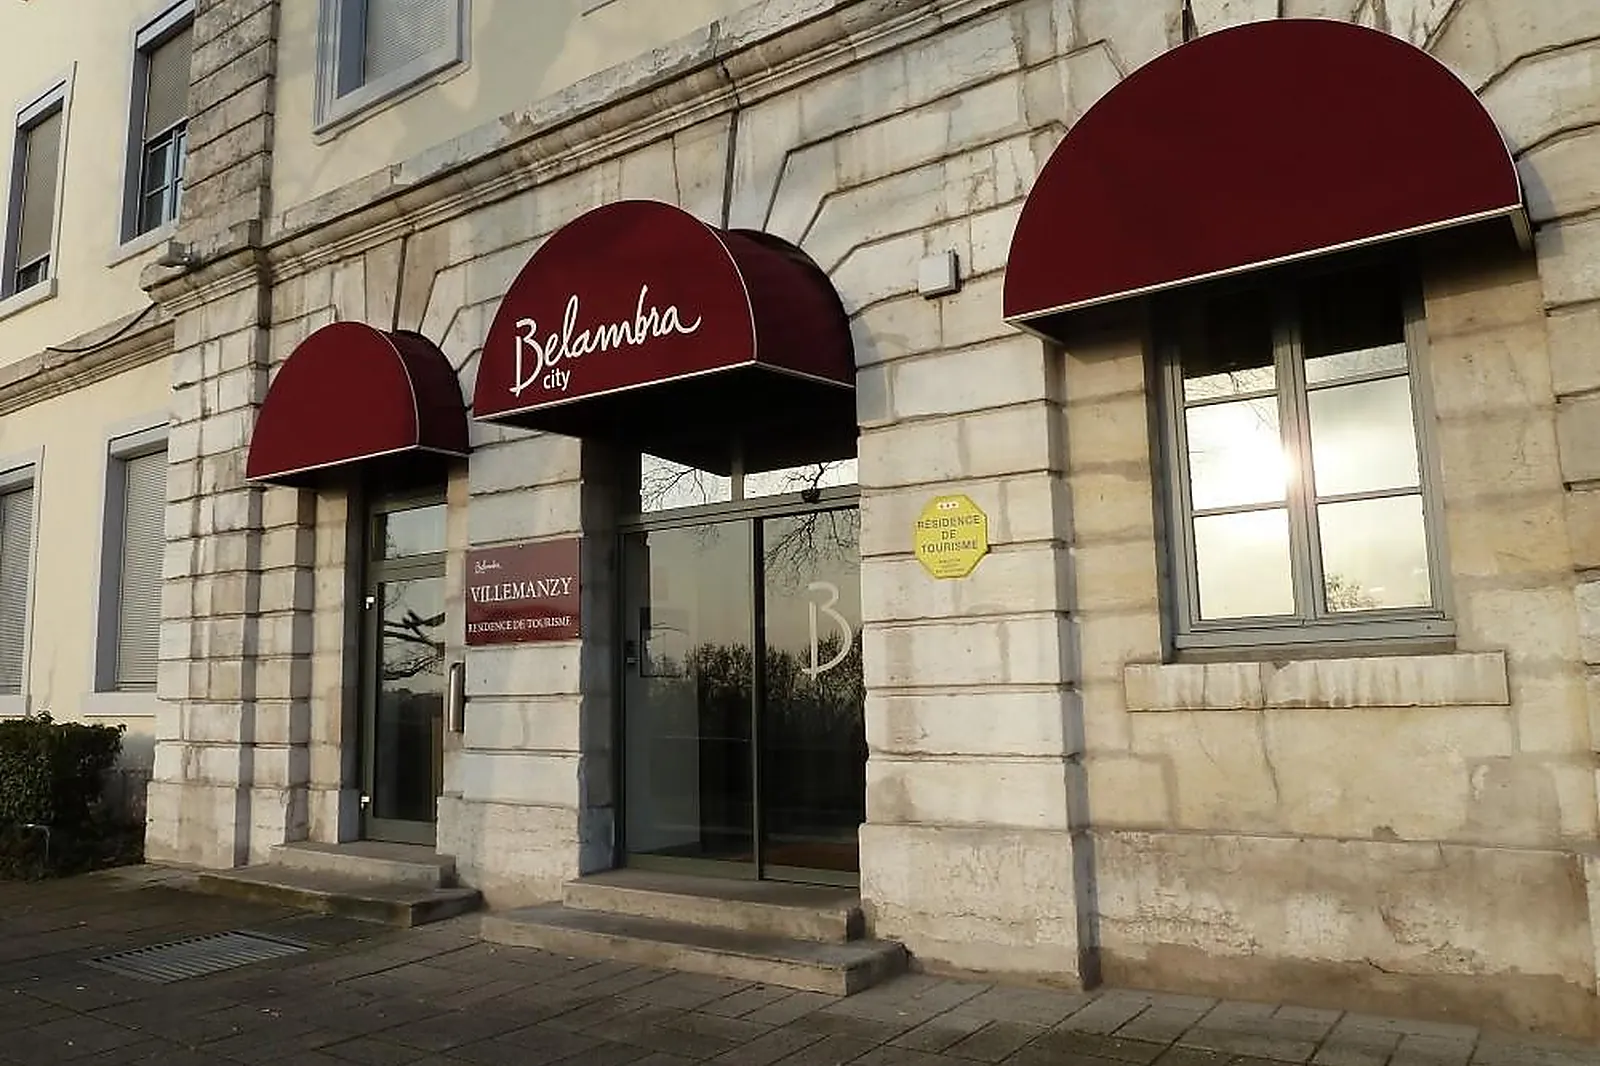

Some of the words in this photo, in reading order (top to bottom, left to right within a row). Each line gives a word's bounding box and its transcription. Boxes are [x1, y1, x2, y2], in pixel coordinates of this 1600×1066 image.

[509, 284, 702, 398] Belambra
[542, 368, 571, 391] city
[921, 539, 979, 553] TOURISME
[941, 529, 957, 540] DE
[470, 577, 573, 603] VILLEMANZY
[801, 581, 852, 681] B
